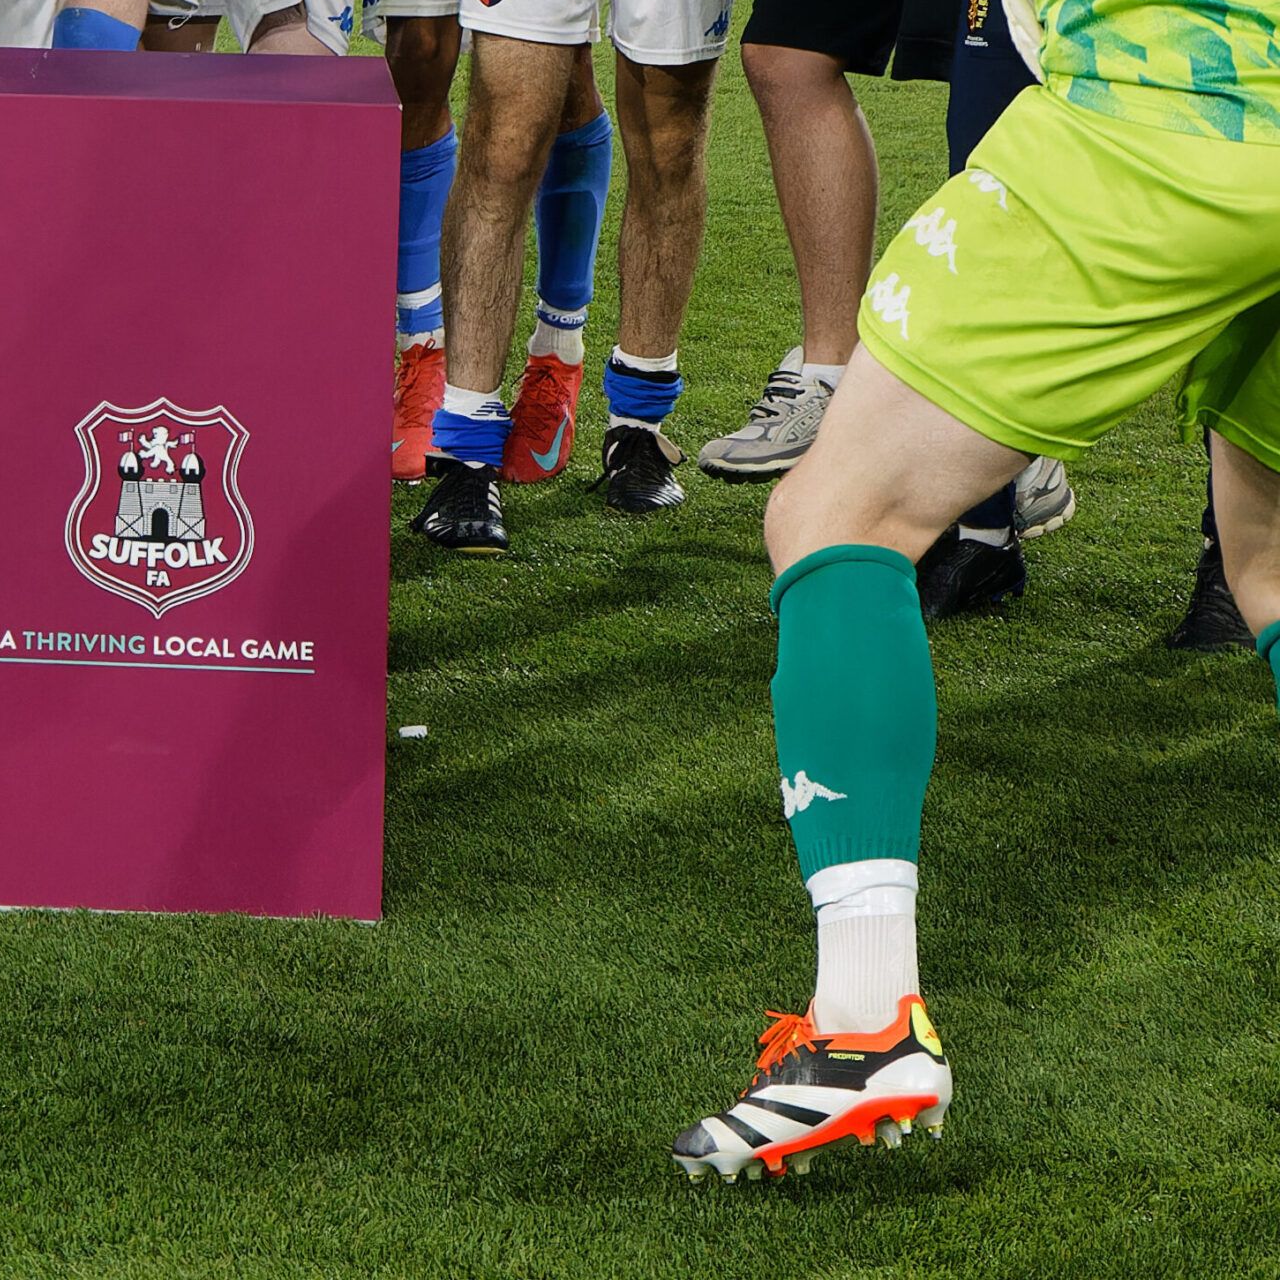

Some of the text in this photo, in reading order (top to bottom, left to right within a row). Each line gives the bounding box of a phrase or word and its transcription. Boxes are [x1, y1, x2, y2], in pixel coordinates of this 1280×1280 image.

[89, 534, 227, 568] SUFFOLK
[146, 570, 170, 587] FA
[0, 630, 314, 661] A THRIVING LOCAL GAME
